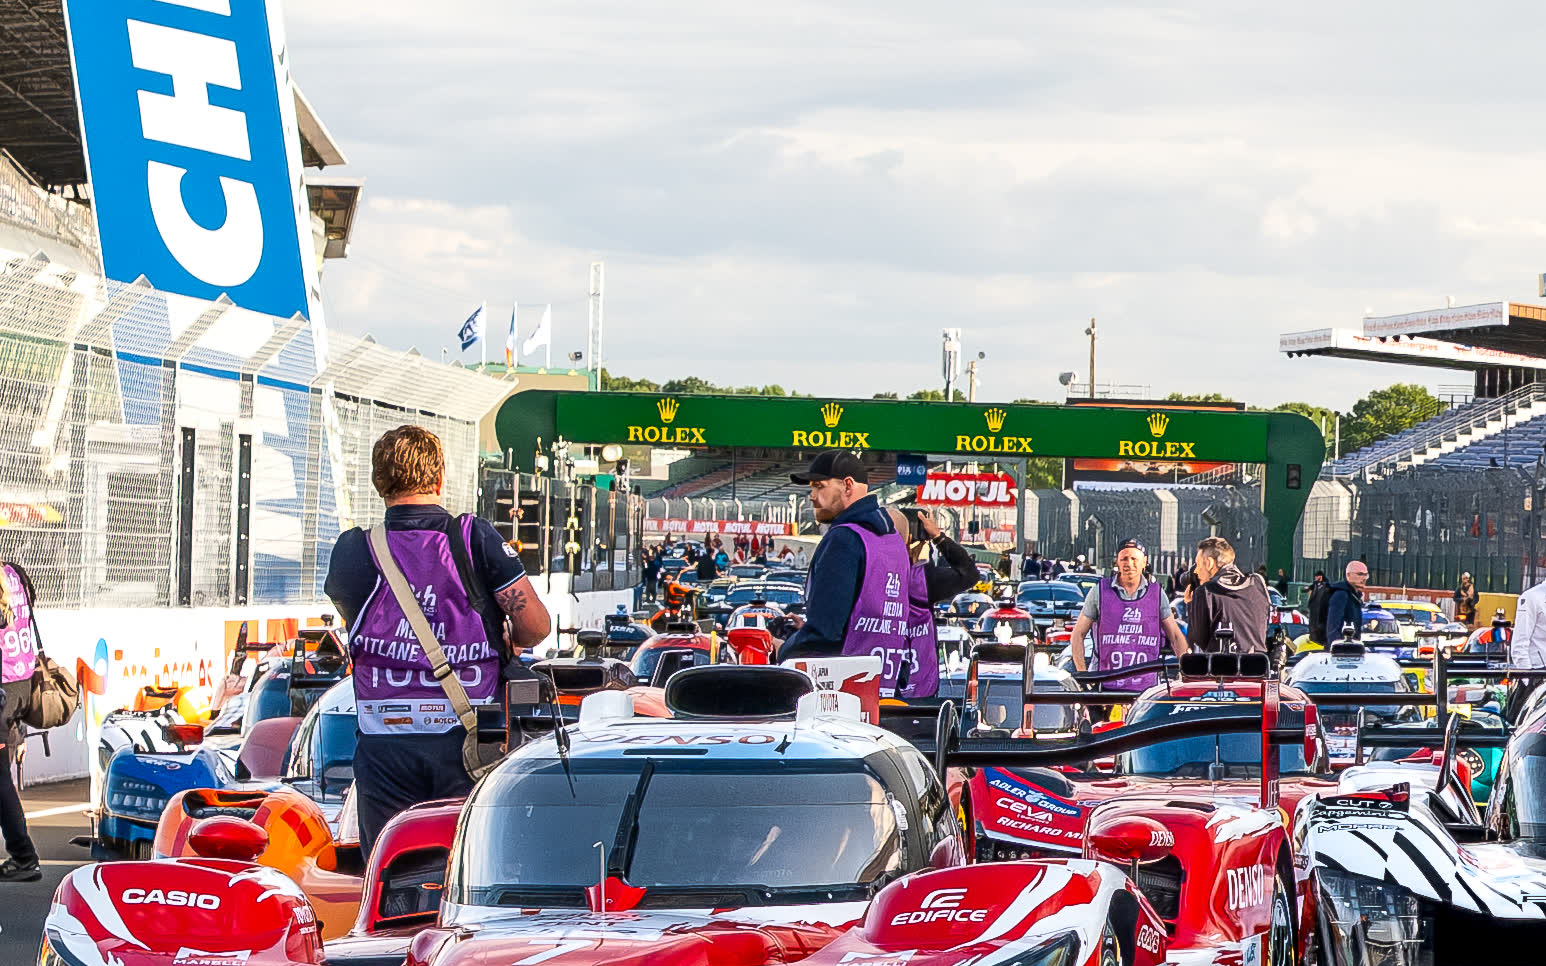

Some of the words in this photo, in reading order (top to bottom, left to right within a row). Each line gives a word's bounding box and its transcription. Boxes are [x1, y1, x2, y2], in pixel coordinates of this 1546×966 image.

[628, 426, 706, 444] ROLEX
[792, 430, 871, 448] ROLEX
[956, 435, 1033, 453] ROLEX
[1119, 440, 1196, 458] ROLEX
[921, 480, 1011, 502] MOTUL
[883, 601, 902, 617] MEDIA
[395, 619, 446, 641] MIA
[854, 617, 891, 635] PITLANE
[1118, 624, 1143, 634] MEDIA
[1102, 634, 1130, 645] PITLANE
[820, 693, 839, 712] TOYOTA
[581, 734, 775, 745] DENSO
[990, 779, 1027, 798] ADLER
[1039, 800, 1079, 817] GROUP
[997, 817, 1063, 837] RICHARD
[1227, 864, 1264, 910] DENSO
[121, 888, 221, 910] CASIO
[890, 909, 988, 926] EDIFICE
[512, 939, 594, 966] 7
[173, 958, 247, 966] MARELLI
